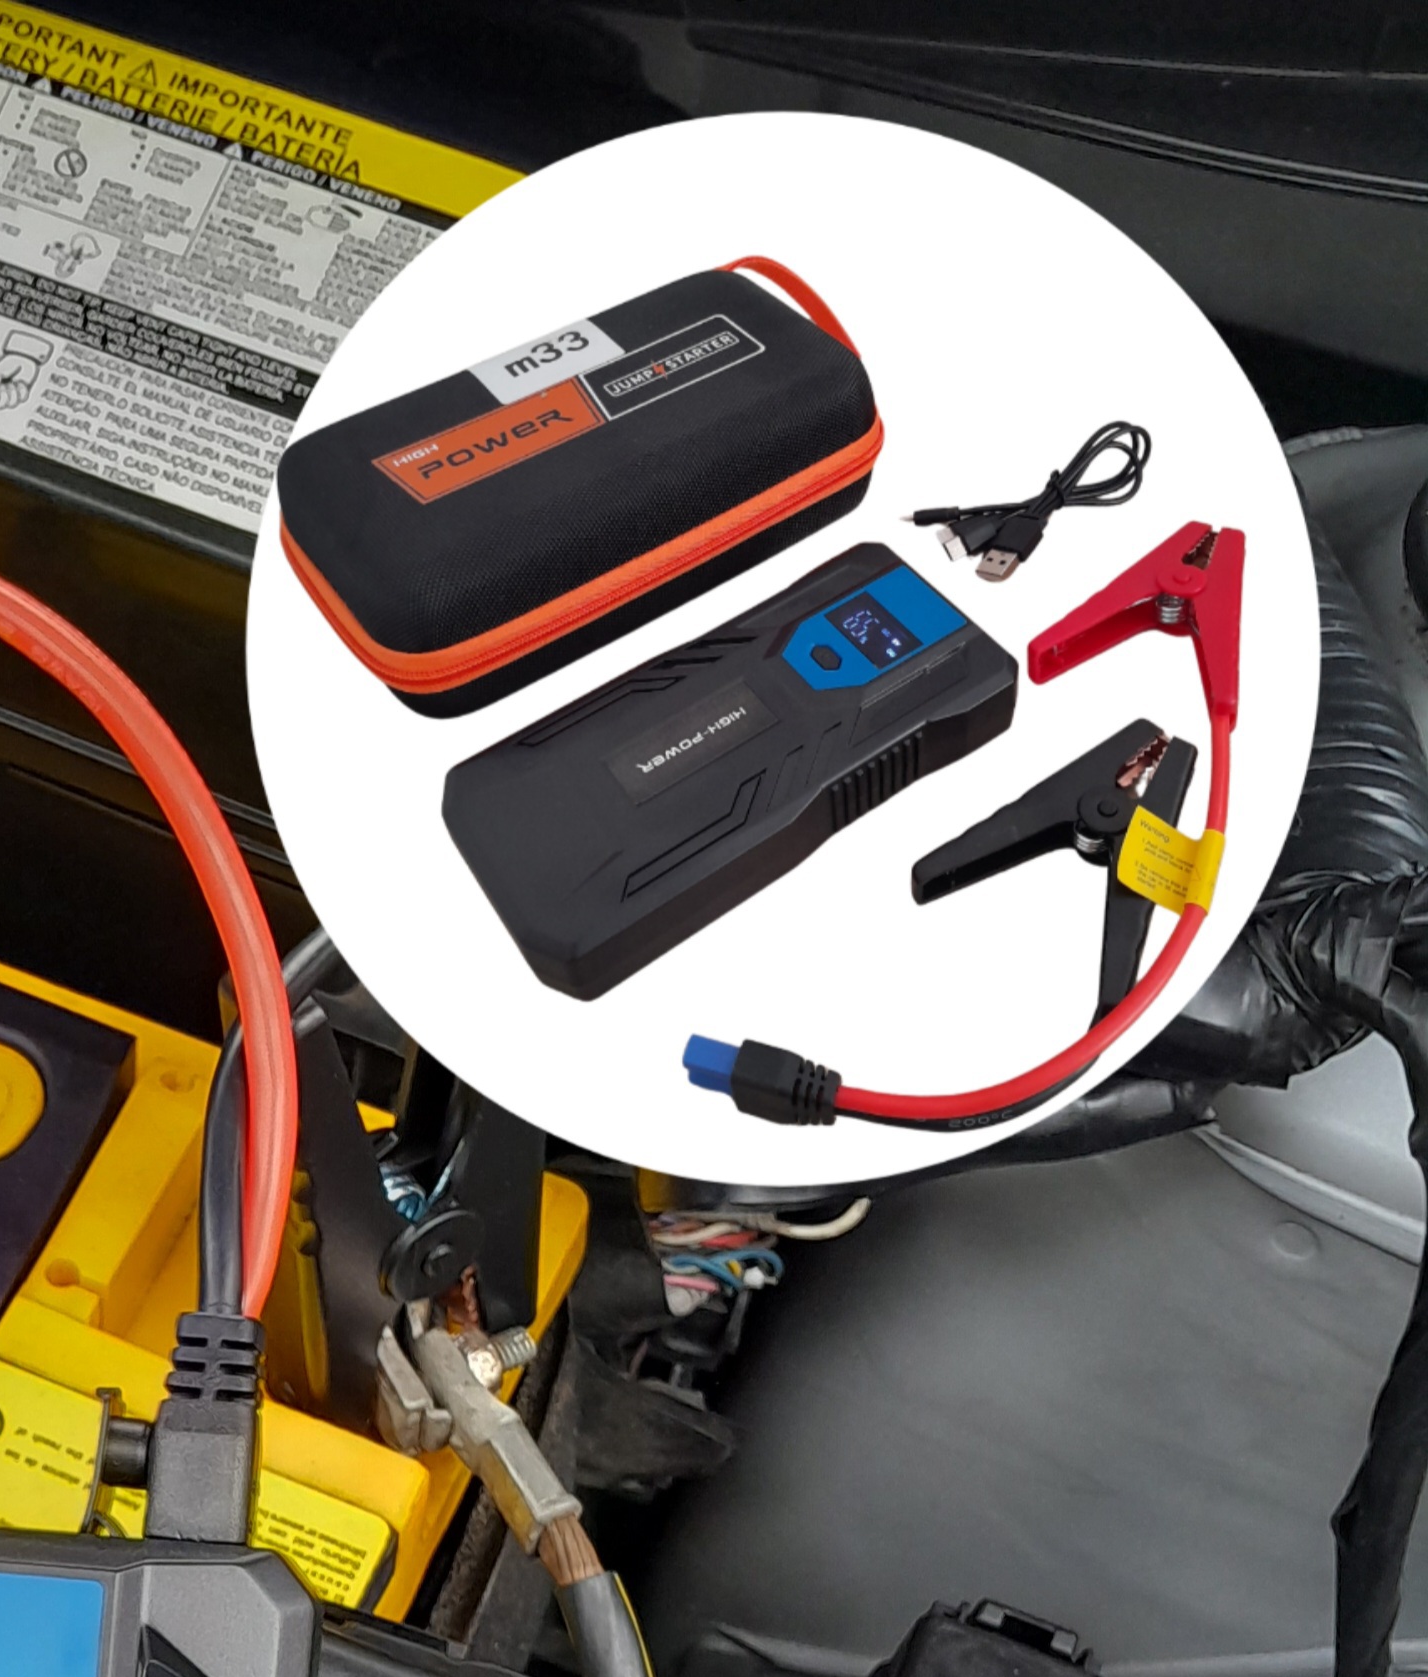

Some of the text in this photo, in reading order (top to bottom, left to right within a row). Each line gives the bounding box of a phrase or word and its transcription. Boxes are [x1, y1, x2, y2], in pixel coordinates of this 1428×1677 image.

[60, 86, 135, 121] PELIGRO
[145, 115, 218, 149] VENENO
[77, 66, 217, 131] BATTERIE
[166, 70, 353, 149] IMPORTANTE
[249, 151, 316, 184] PERIGO
[327, 178, 401, 213] VENENO
[501, 323, 591, 382] m33
[609, 330, 734, 396] JUMP STARTER
[392, 440, 439, 470] HIGH
[635, 706, 746, 774] HIGH-POWER
